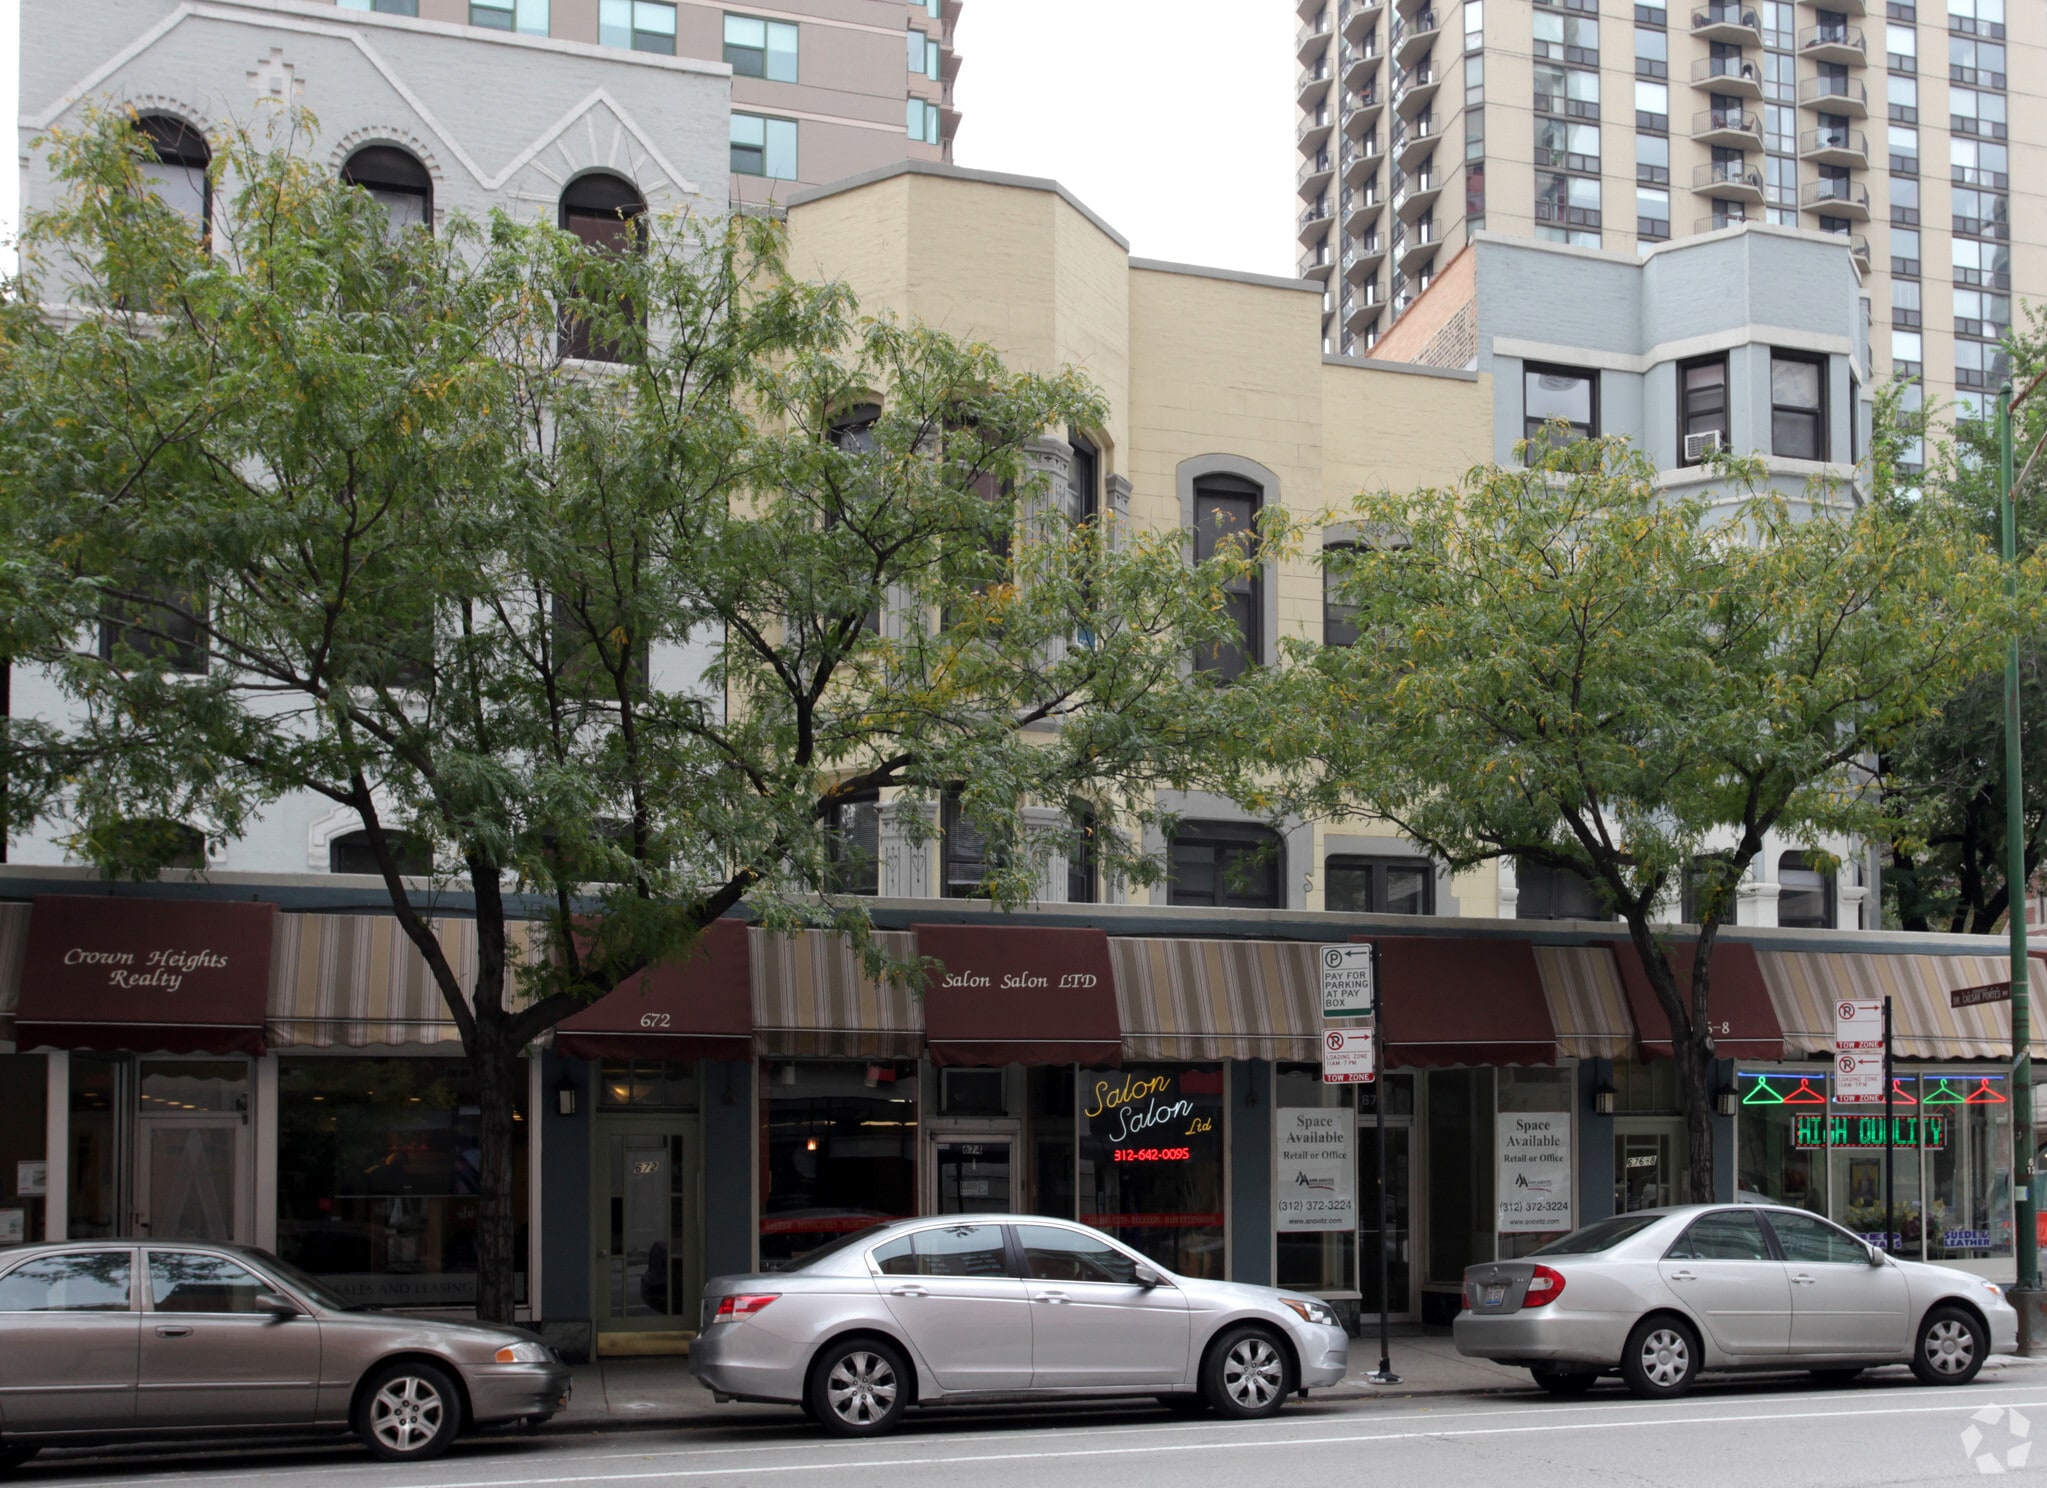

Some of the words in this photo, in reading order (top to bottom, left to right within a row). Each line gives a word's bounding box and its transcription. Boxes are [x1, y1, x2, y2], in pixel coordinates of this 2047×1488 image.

[64, 948, 135, 965] Crown
[146, 949, 229, 972] Heights
[108, 968, 182, 992] Realty
[942, 970, 991, 988] Salon
[1000, 971, 1048, 989] Salon
[1058, 973, 1097, 988] LTD
[1325, 972, 1343, 980] PAY
[1347, 971, 1366, 979] FOR
[1325, 980, 1368, 989] PARKING
[1326, 990, 1337, 998] AT
[1341, 989, 1360, 997] PAY
[1326, 999, 1345, 1007] BOX
[640, 1013, 671, 1027] 672
[1084, 1073, 1171, 1117] Salon
[1109, 1097, 1194, 1142] Salon
[1297, 1114, 1333, 1130] Space
[1185, 1117, 1212, 1135] Ltd
[1516, 1119, 1550, 1133] Space
[1798, 1117, 1847, 1145] HIGH
[1286, 1131, 1344, 1143] Available
[1506, 1135, 1560, 1147] Available
[962, 1144, 983, 1154] 674
[1114, 1148, 1190, 1161] 312-642-0095
[1283, 1151, 1308, 1160] Retail
[1322, 1151, 1347, 1160] Office
[1504, 1154, 1527, 1163] Retail
[1539, 1154, 1563, 1162] Office
[1627, 1156, 1656, 1167] 676-8
[635, 1162, 658, 1173] 672
[1279, 1200, 1303, 1212] (312)
[1306, 1200, 1352, 1211] 372-3224
[1500, 1201, 1522, 1213] (312)
[1526, 1202, 1568, 1212] 372-3224
[1944, 1231, 1977, 1239] SUEDE
